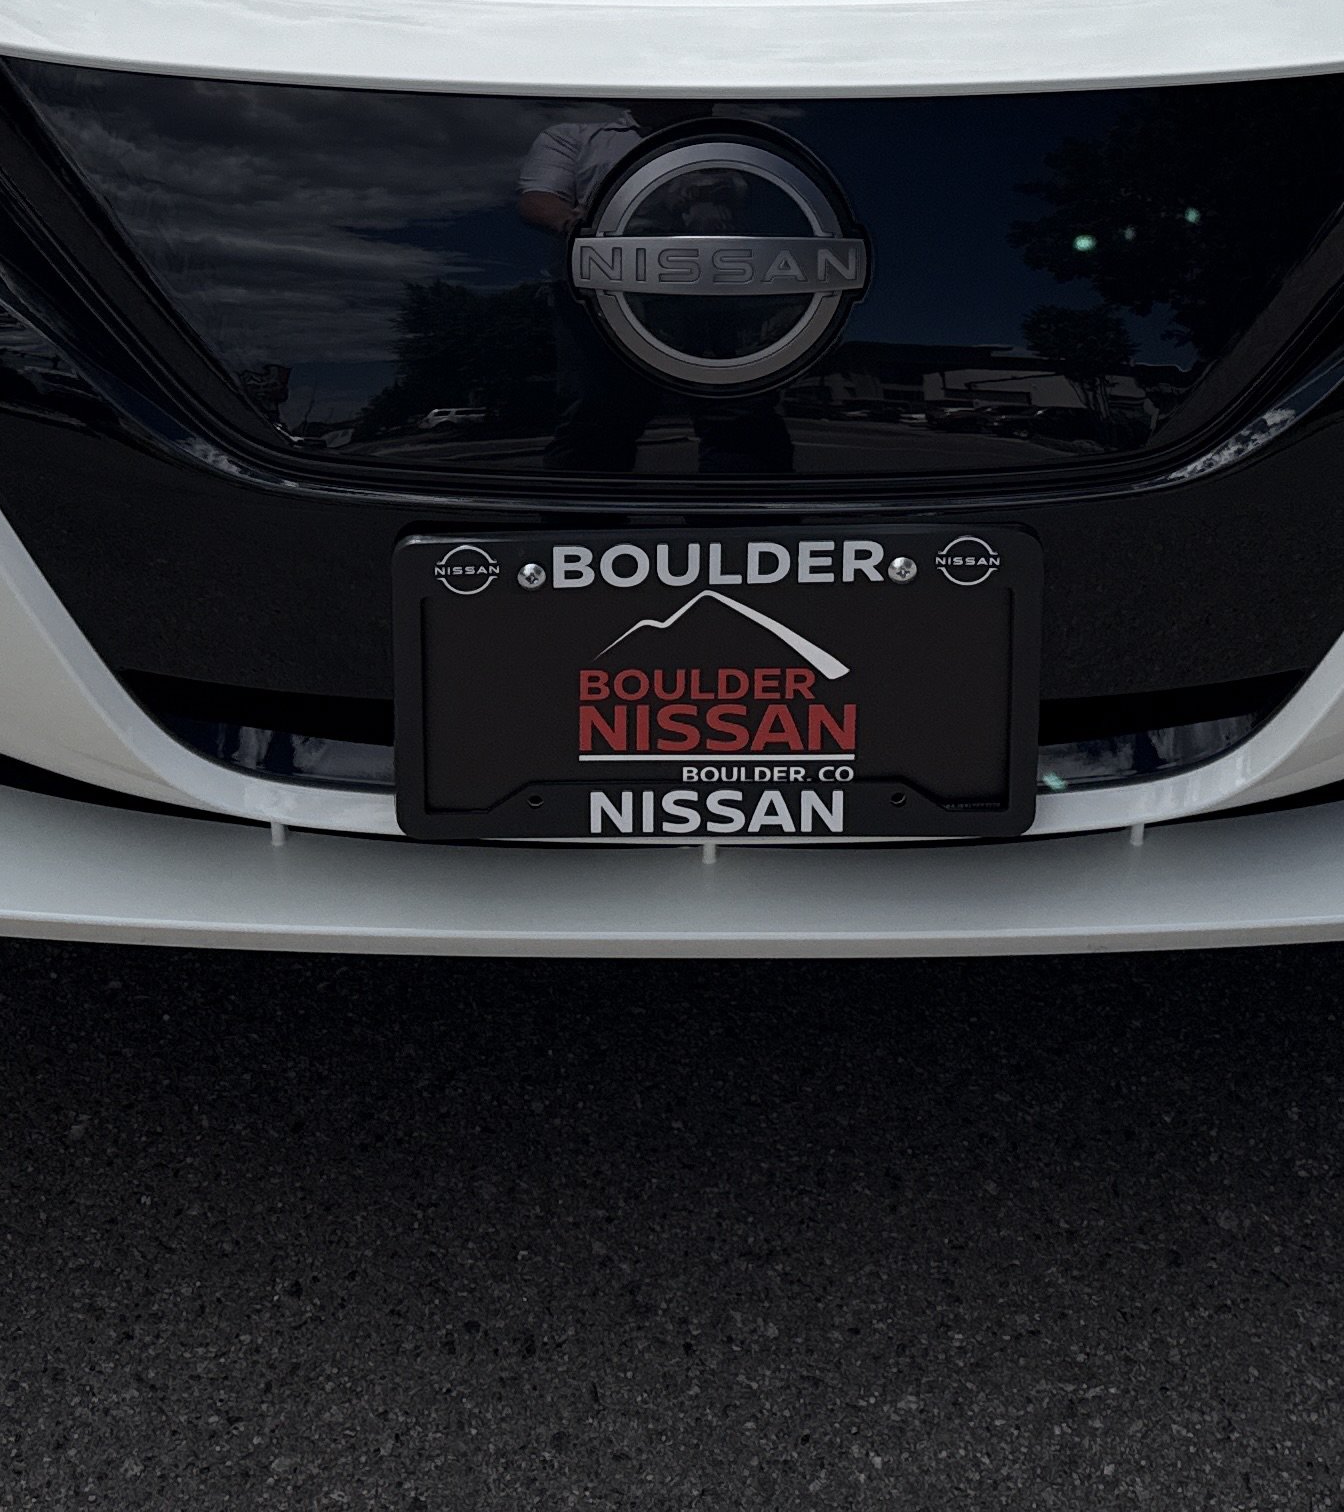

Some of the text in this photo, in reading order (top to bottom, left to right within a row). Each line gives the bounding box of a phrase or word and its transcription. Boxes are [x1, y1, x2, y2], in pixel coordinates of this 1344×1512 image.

[579, 245, 857, 285] NISSAN
[434, 565, 500, 576] NISSAN
[552, 540, 885, 589] BOULDER
[935, 556, 1001, 566] NISSAN
[579, 668, 817, 701] BOULDER
[578, 703, 856, 752] NISSAN
[818, 766, 855, 782] CO
[589, 790, 844, 834] NISSAN
